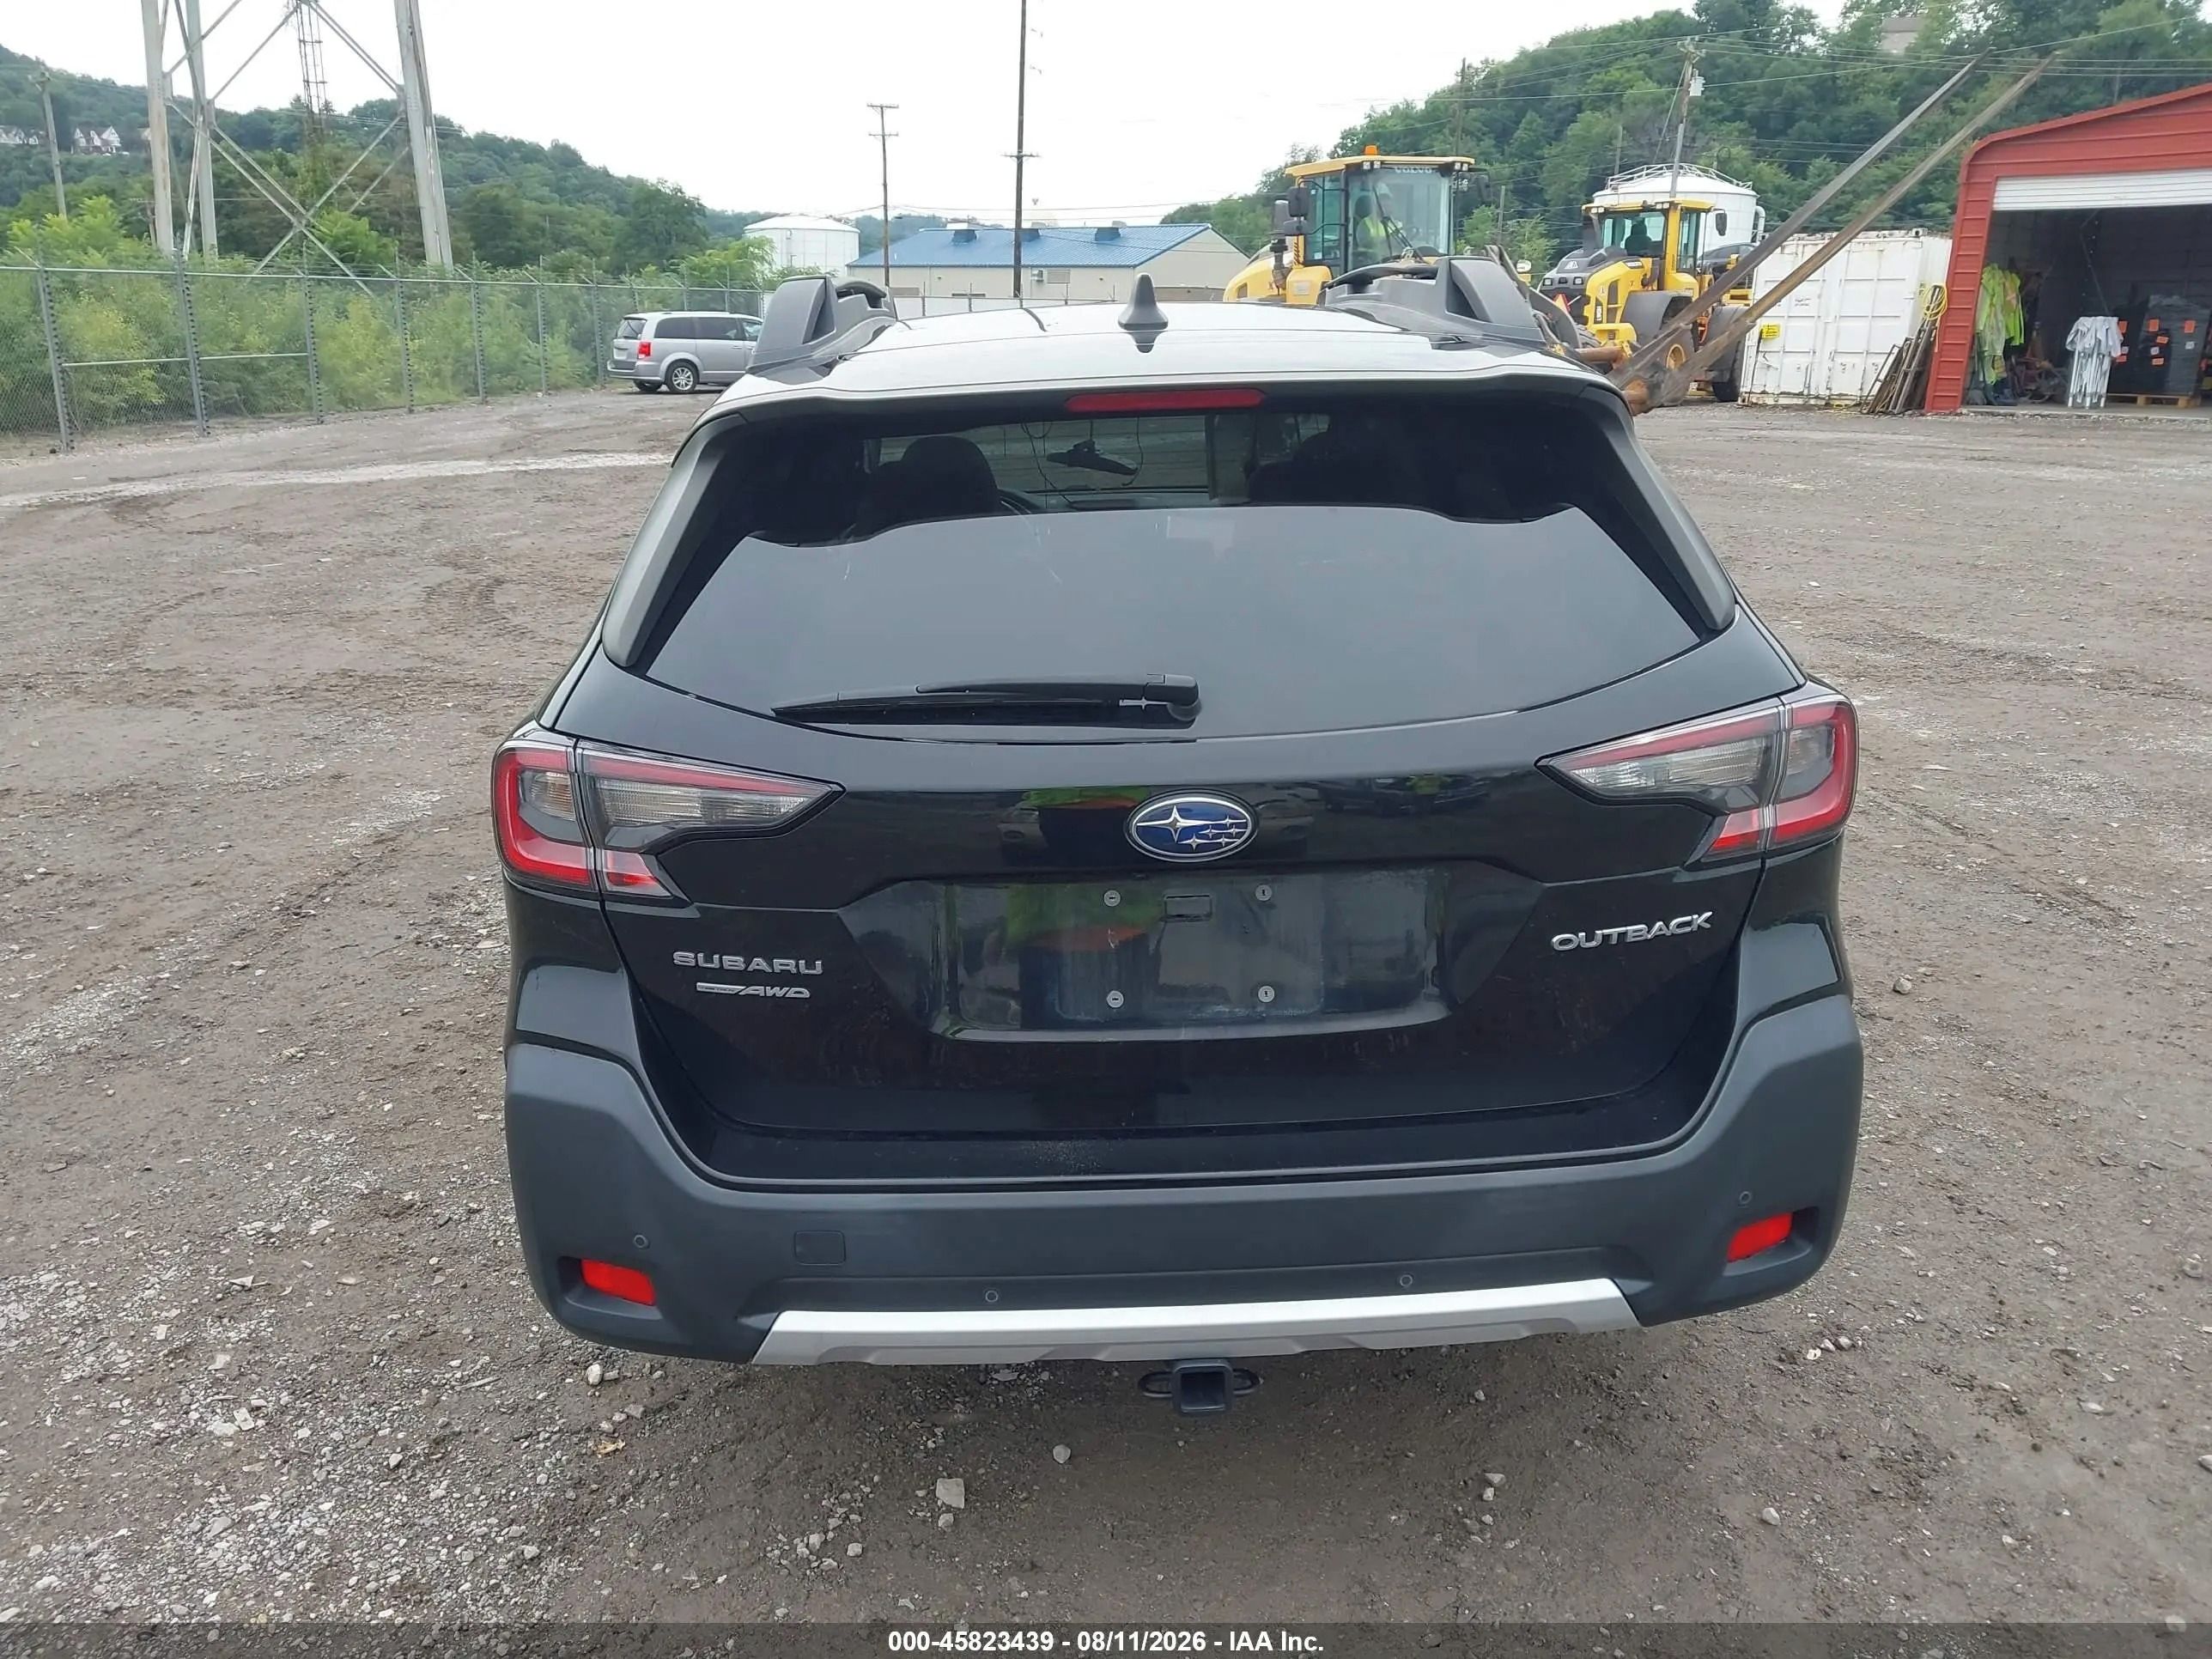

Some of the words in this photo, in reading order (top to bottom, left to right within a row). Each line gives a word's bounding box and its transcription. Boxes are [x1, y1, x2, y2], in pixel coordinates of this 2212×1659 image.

[1551, 911, 1713, 951] OUTBACK
[672, 951, 823, 975] SUBARU
[738, 986, 811, 998] AWD
